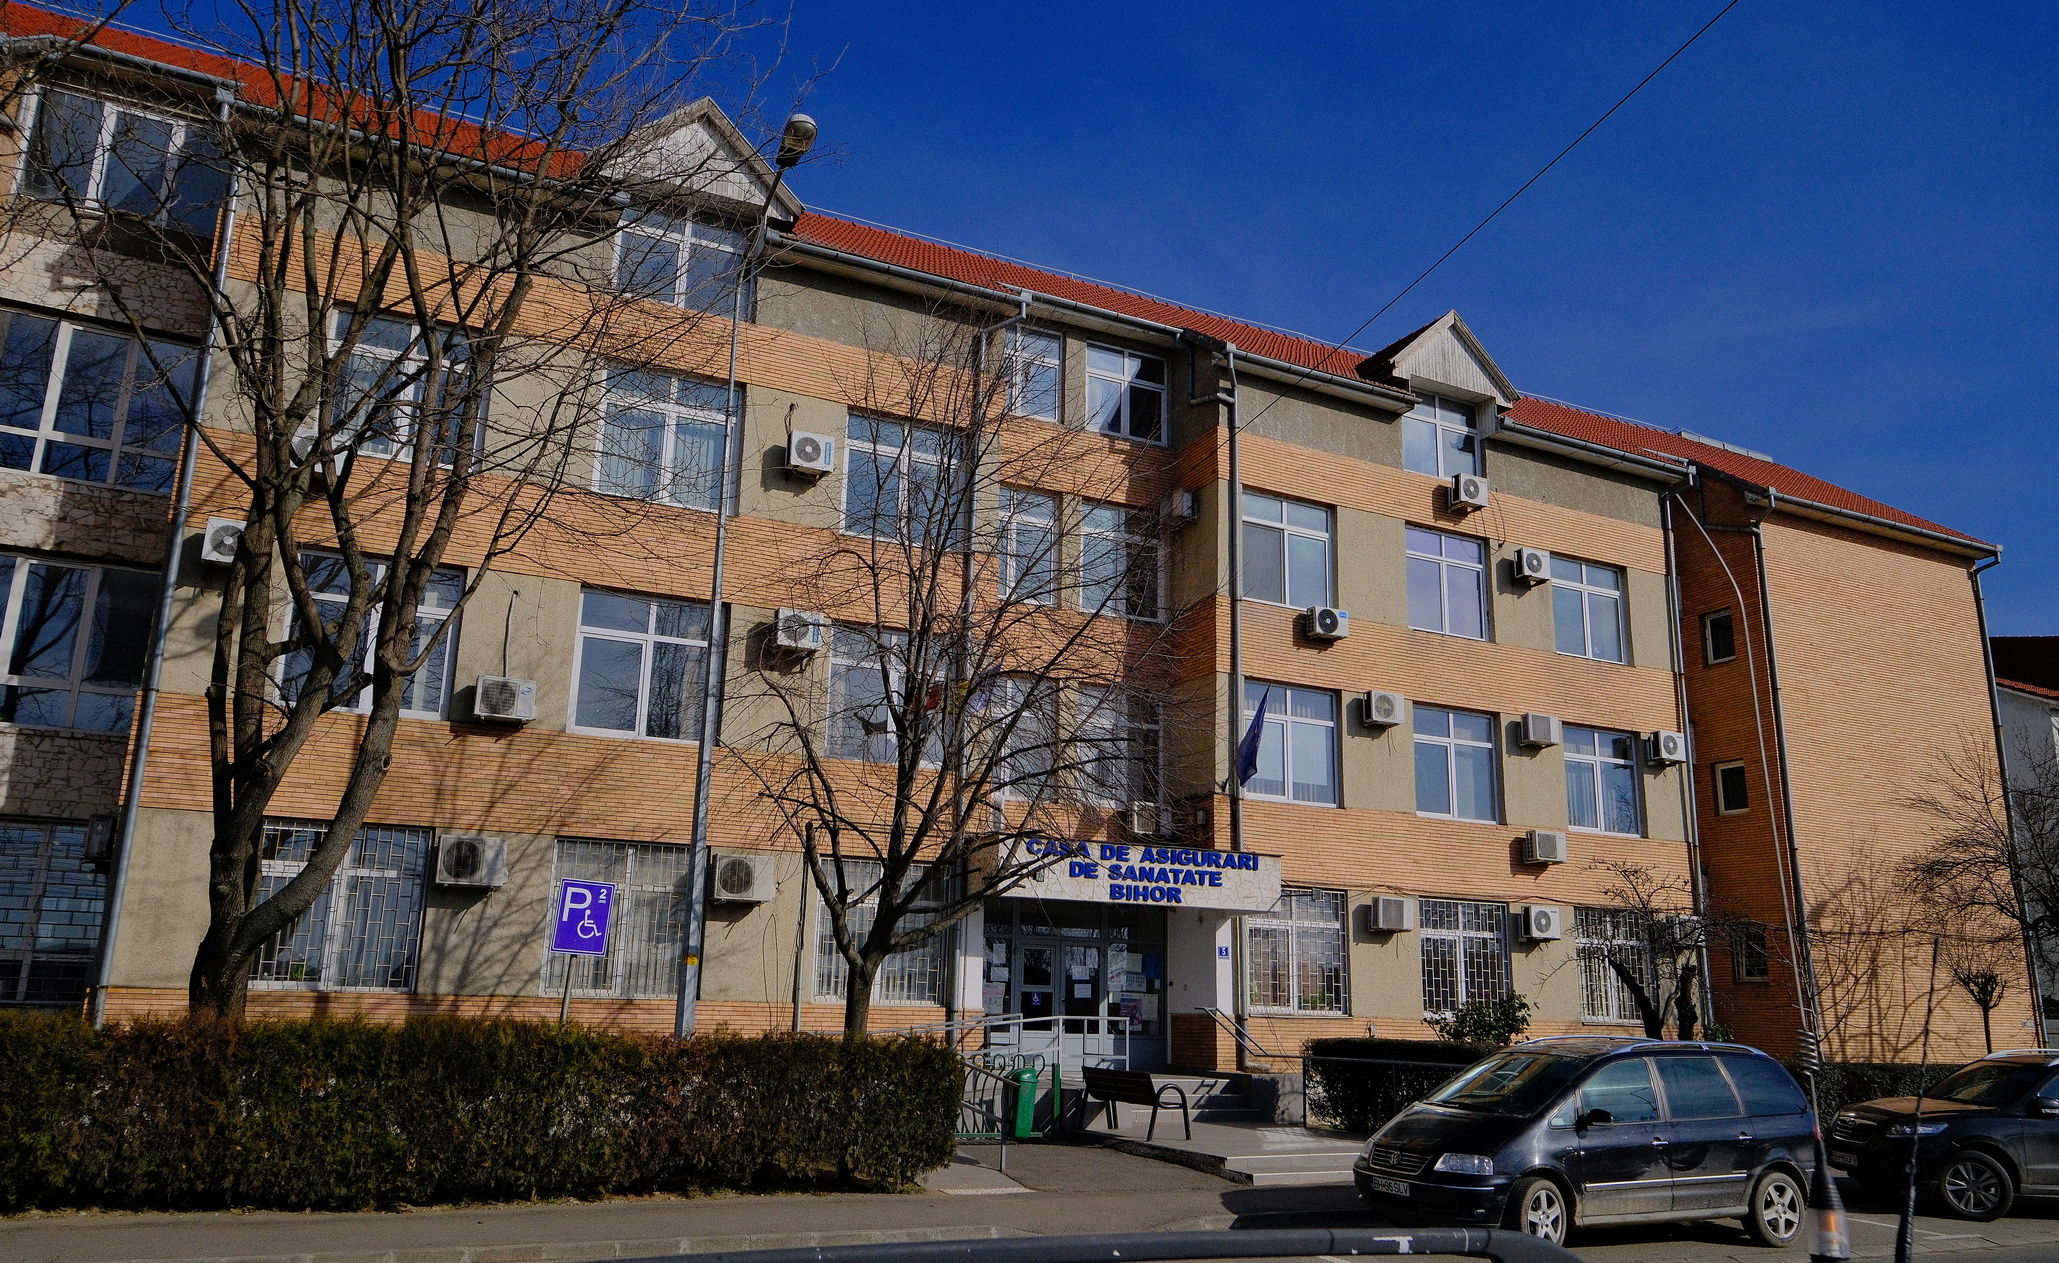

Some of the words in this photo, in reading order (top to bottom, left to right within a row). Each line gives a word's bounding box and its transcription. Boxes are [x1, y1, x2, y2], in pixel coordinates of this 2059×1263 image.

[1100, 844, 1130, 861] DE
[1140, 847, 1258, 870] ASIGURARI
[1069, 861, 1098, 879] DE
[1108, 865, 1223, 887] SANATATE
[562, 887, 592, 922] P
[598, 888, 607, 899] 2
[1109, 884, 1183, 903] BIHOR
[1221, 947, 1226, 956] 5
